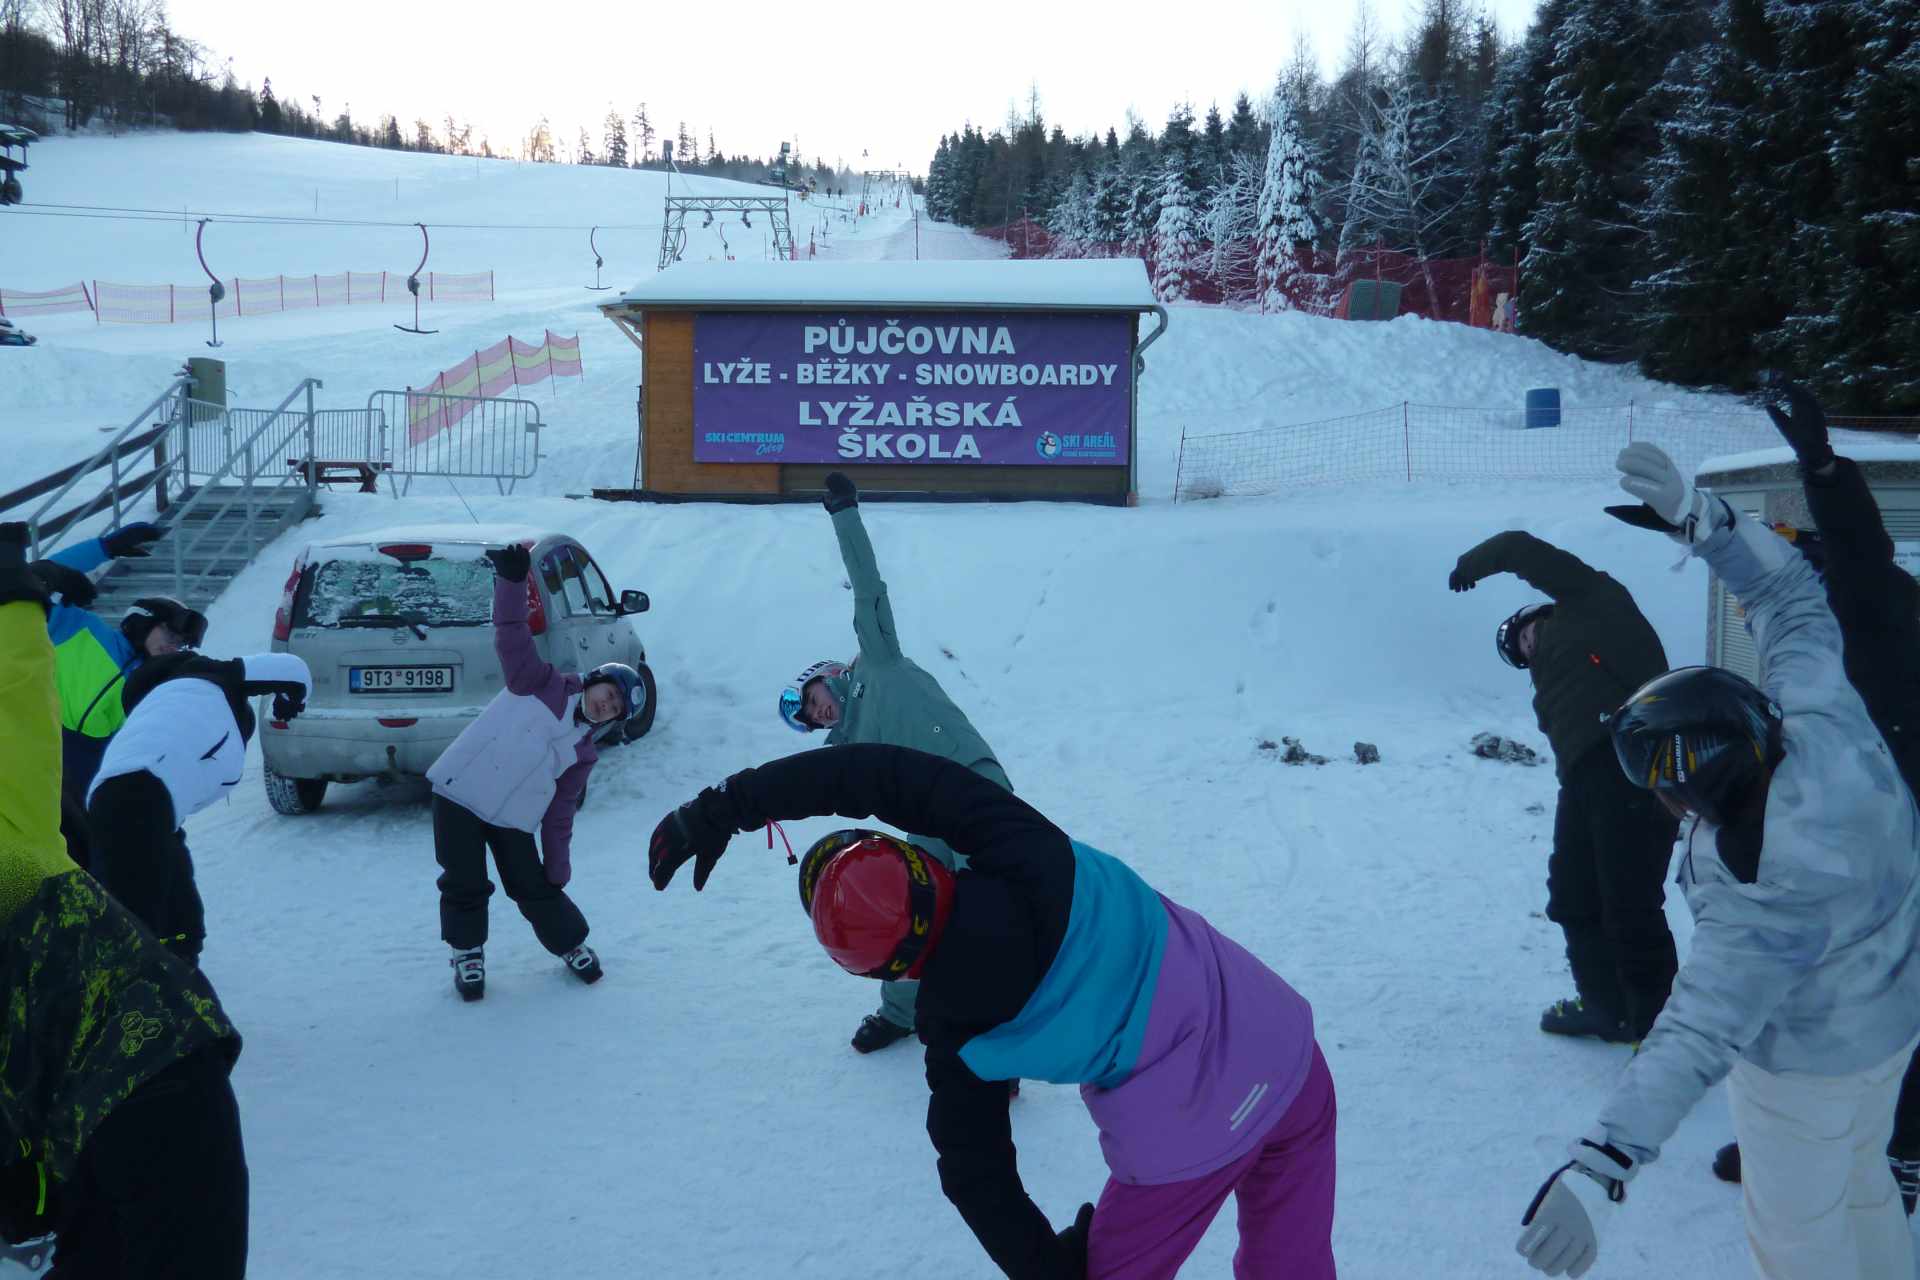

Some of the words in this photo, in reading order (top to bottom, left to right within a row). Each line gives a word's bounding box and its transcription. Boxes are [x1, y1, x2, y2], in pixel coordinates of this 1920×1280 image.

[804, 319, 1015, 354] PŮJČOVNA
[704, 358, 771, 384] LYŽE
[797, 358, 890, 385] BĚŽKY
[915, 364, 1117, 385] SNOWBOARDY
[799, 395, 1022, 427] LYŽAŘSKÁ
[837, 428, 981, 459] ŠKOLA
[1063, 434, 1080, 448] SKI
[364, 670, 392, 686] 9T3
[405, 670, 444, 686] 9198
